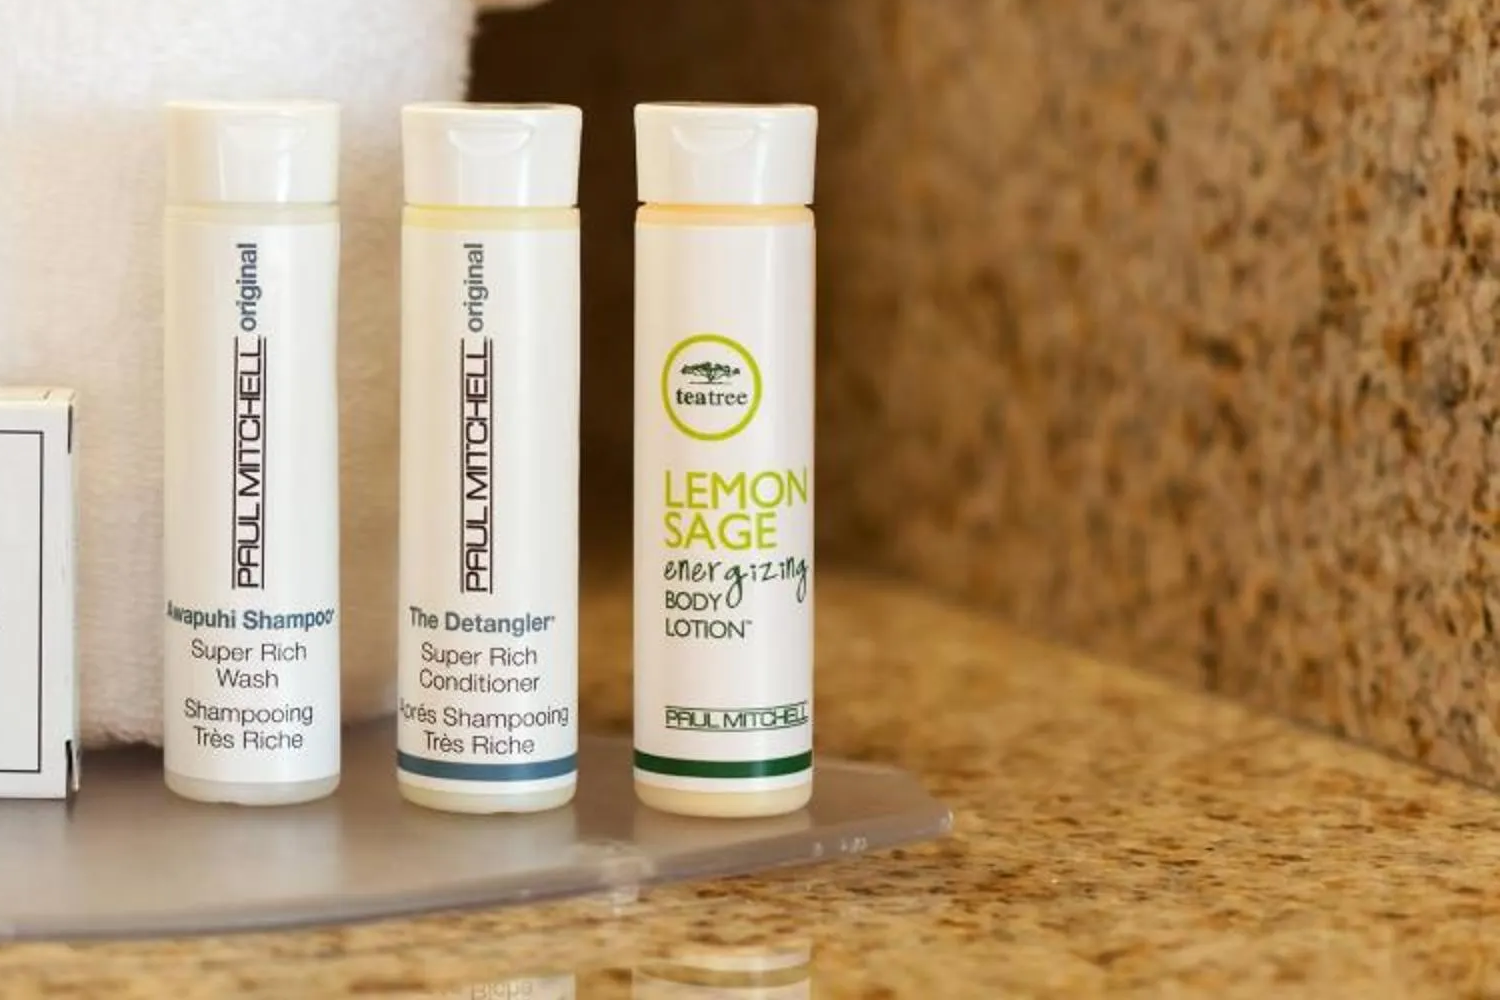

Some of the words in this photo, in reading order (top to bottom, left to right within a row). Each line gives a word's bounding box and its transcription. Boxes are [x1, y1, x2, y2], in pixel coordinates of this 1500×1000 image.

[236, 243, 261, 332] original
[463, 243, 488, 333] original
[237, 336, 262, 497] MITCHELL
[465, 336, 488, 501] MITCHELL
[664, 465, 808, 510] LEMON
[663, 511, 778, 550] SAGE
[237, 503, 262, 589] PAUL
[465, 506, 488, 593] PAUL
[663, 556, 809, 608] energizing
[665, 589, 722, 612] BODY
[410, 606, 439, 630] The
[191, 638, 253, 664] Super
[260, 640, 308, 662] Rich
[421, 641, 483, 667] Super
[489, 647, 538, 667] Rich
[216, 667, 279, 690] Wash
[419, 668, 541, 693] Conditioner
[183, 697, 314, 727] Shampooing
[442, 706, 569, 733] Shampooing
[664, 708, 720, 729] PAUL
[193, 724, 236, 749] Très
[242, 730, 304, 751] Riche
[423, 730, 464, 753] Très
[472, 736, 536, 755] Riche
